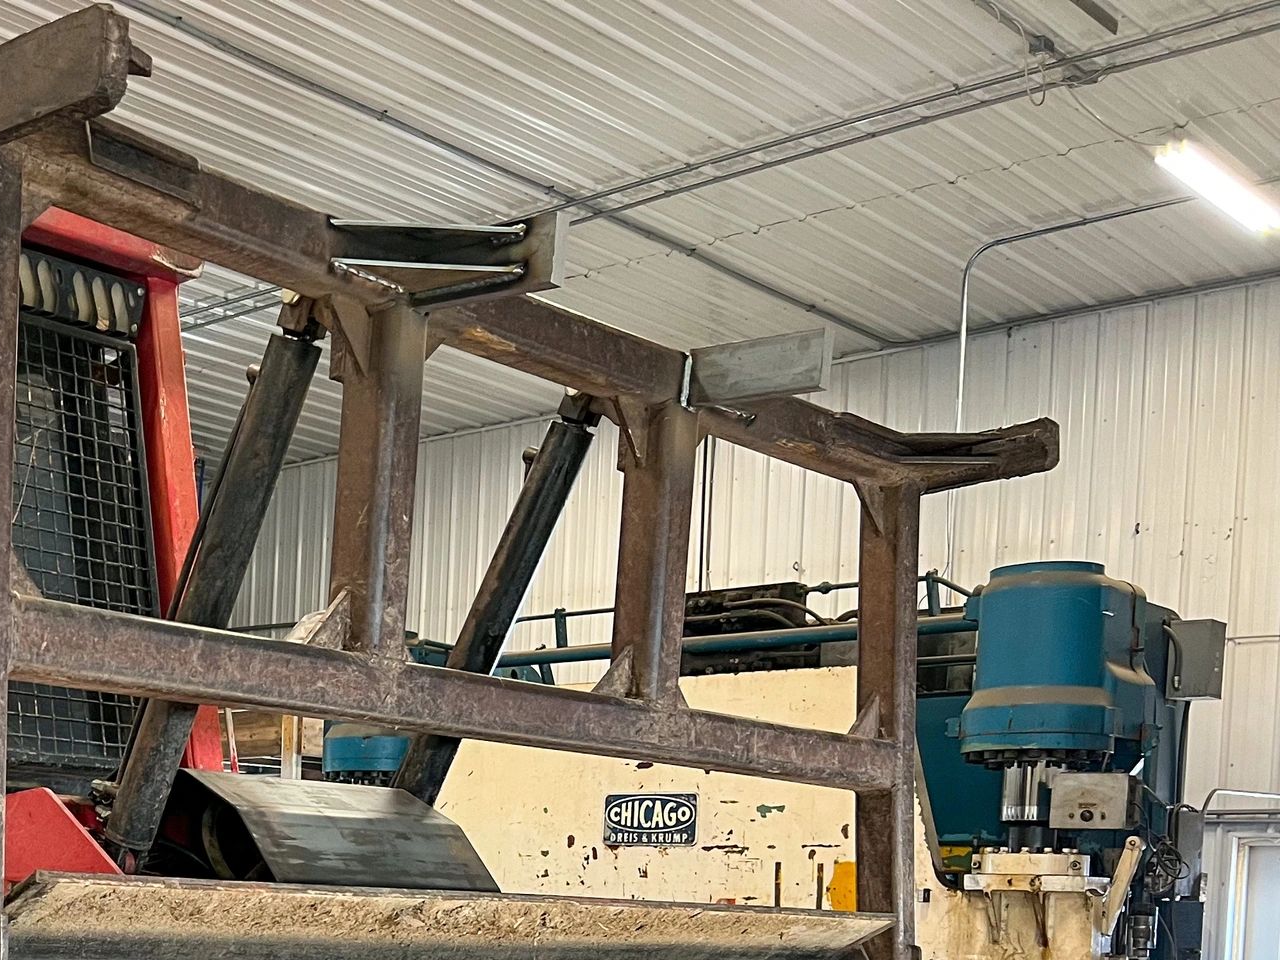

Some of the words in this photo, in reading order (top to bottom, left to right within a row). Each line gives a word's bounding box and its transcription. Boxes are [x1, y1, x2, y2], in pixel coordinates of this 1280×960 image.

[609, 799, 691, 829] CHICAGO
[609, 832, 638, 843] DREIS
[641, 834, 649, 843] &
[651, 833, 689, 844] KRUMP
